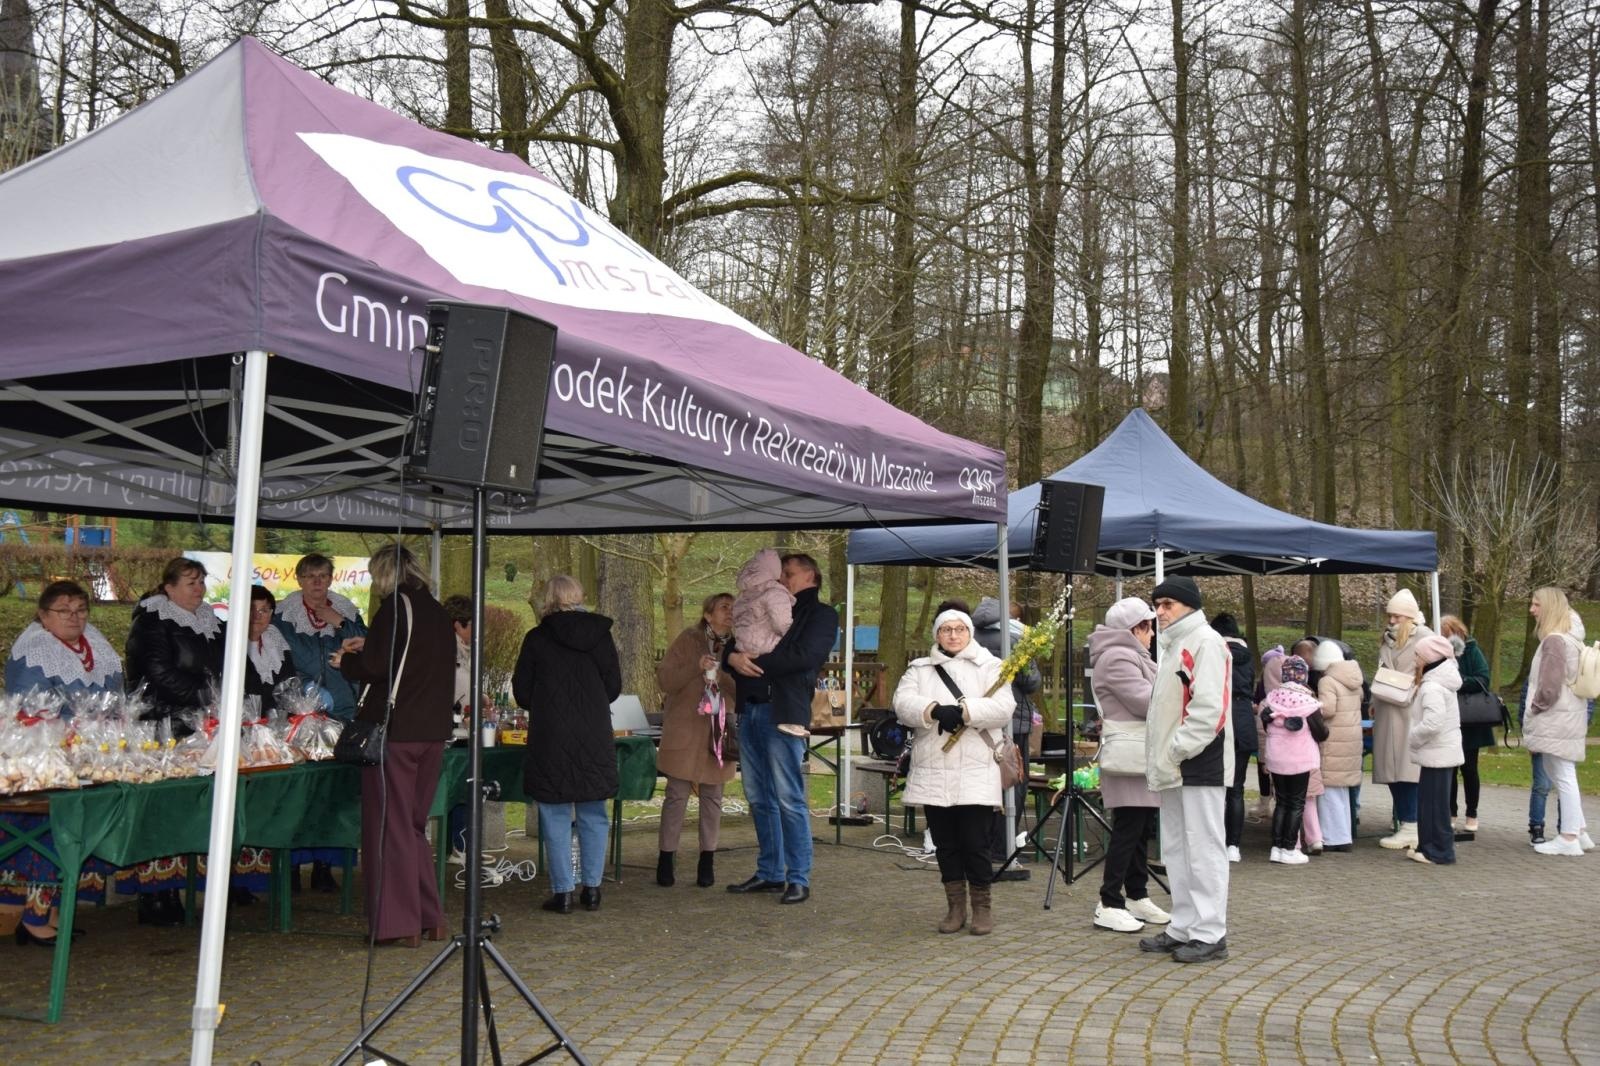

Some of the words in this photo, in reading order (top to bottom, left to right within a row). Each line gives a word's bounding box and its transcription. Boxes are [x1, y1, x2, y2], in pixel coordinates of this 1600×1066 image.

[316, 272, 428, 351] Gmin
[552, 357, 635, 419] odek
[642, 378, 738, 456] Kultury
[740, 411, 751, 451] i
[752, 417, 847, 484] Rekreacji
[850, 455, 866, 485] w
[871, 452, 937, 493] Mszanie
[332, 569, 368, 584] WIĄT
